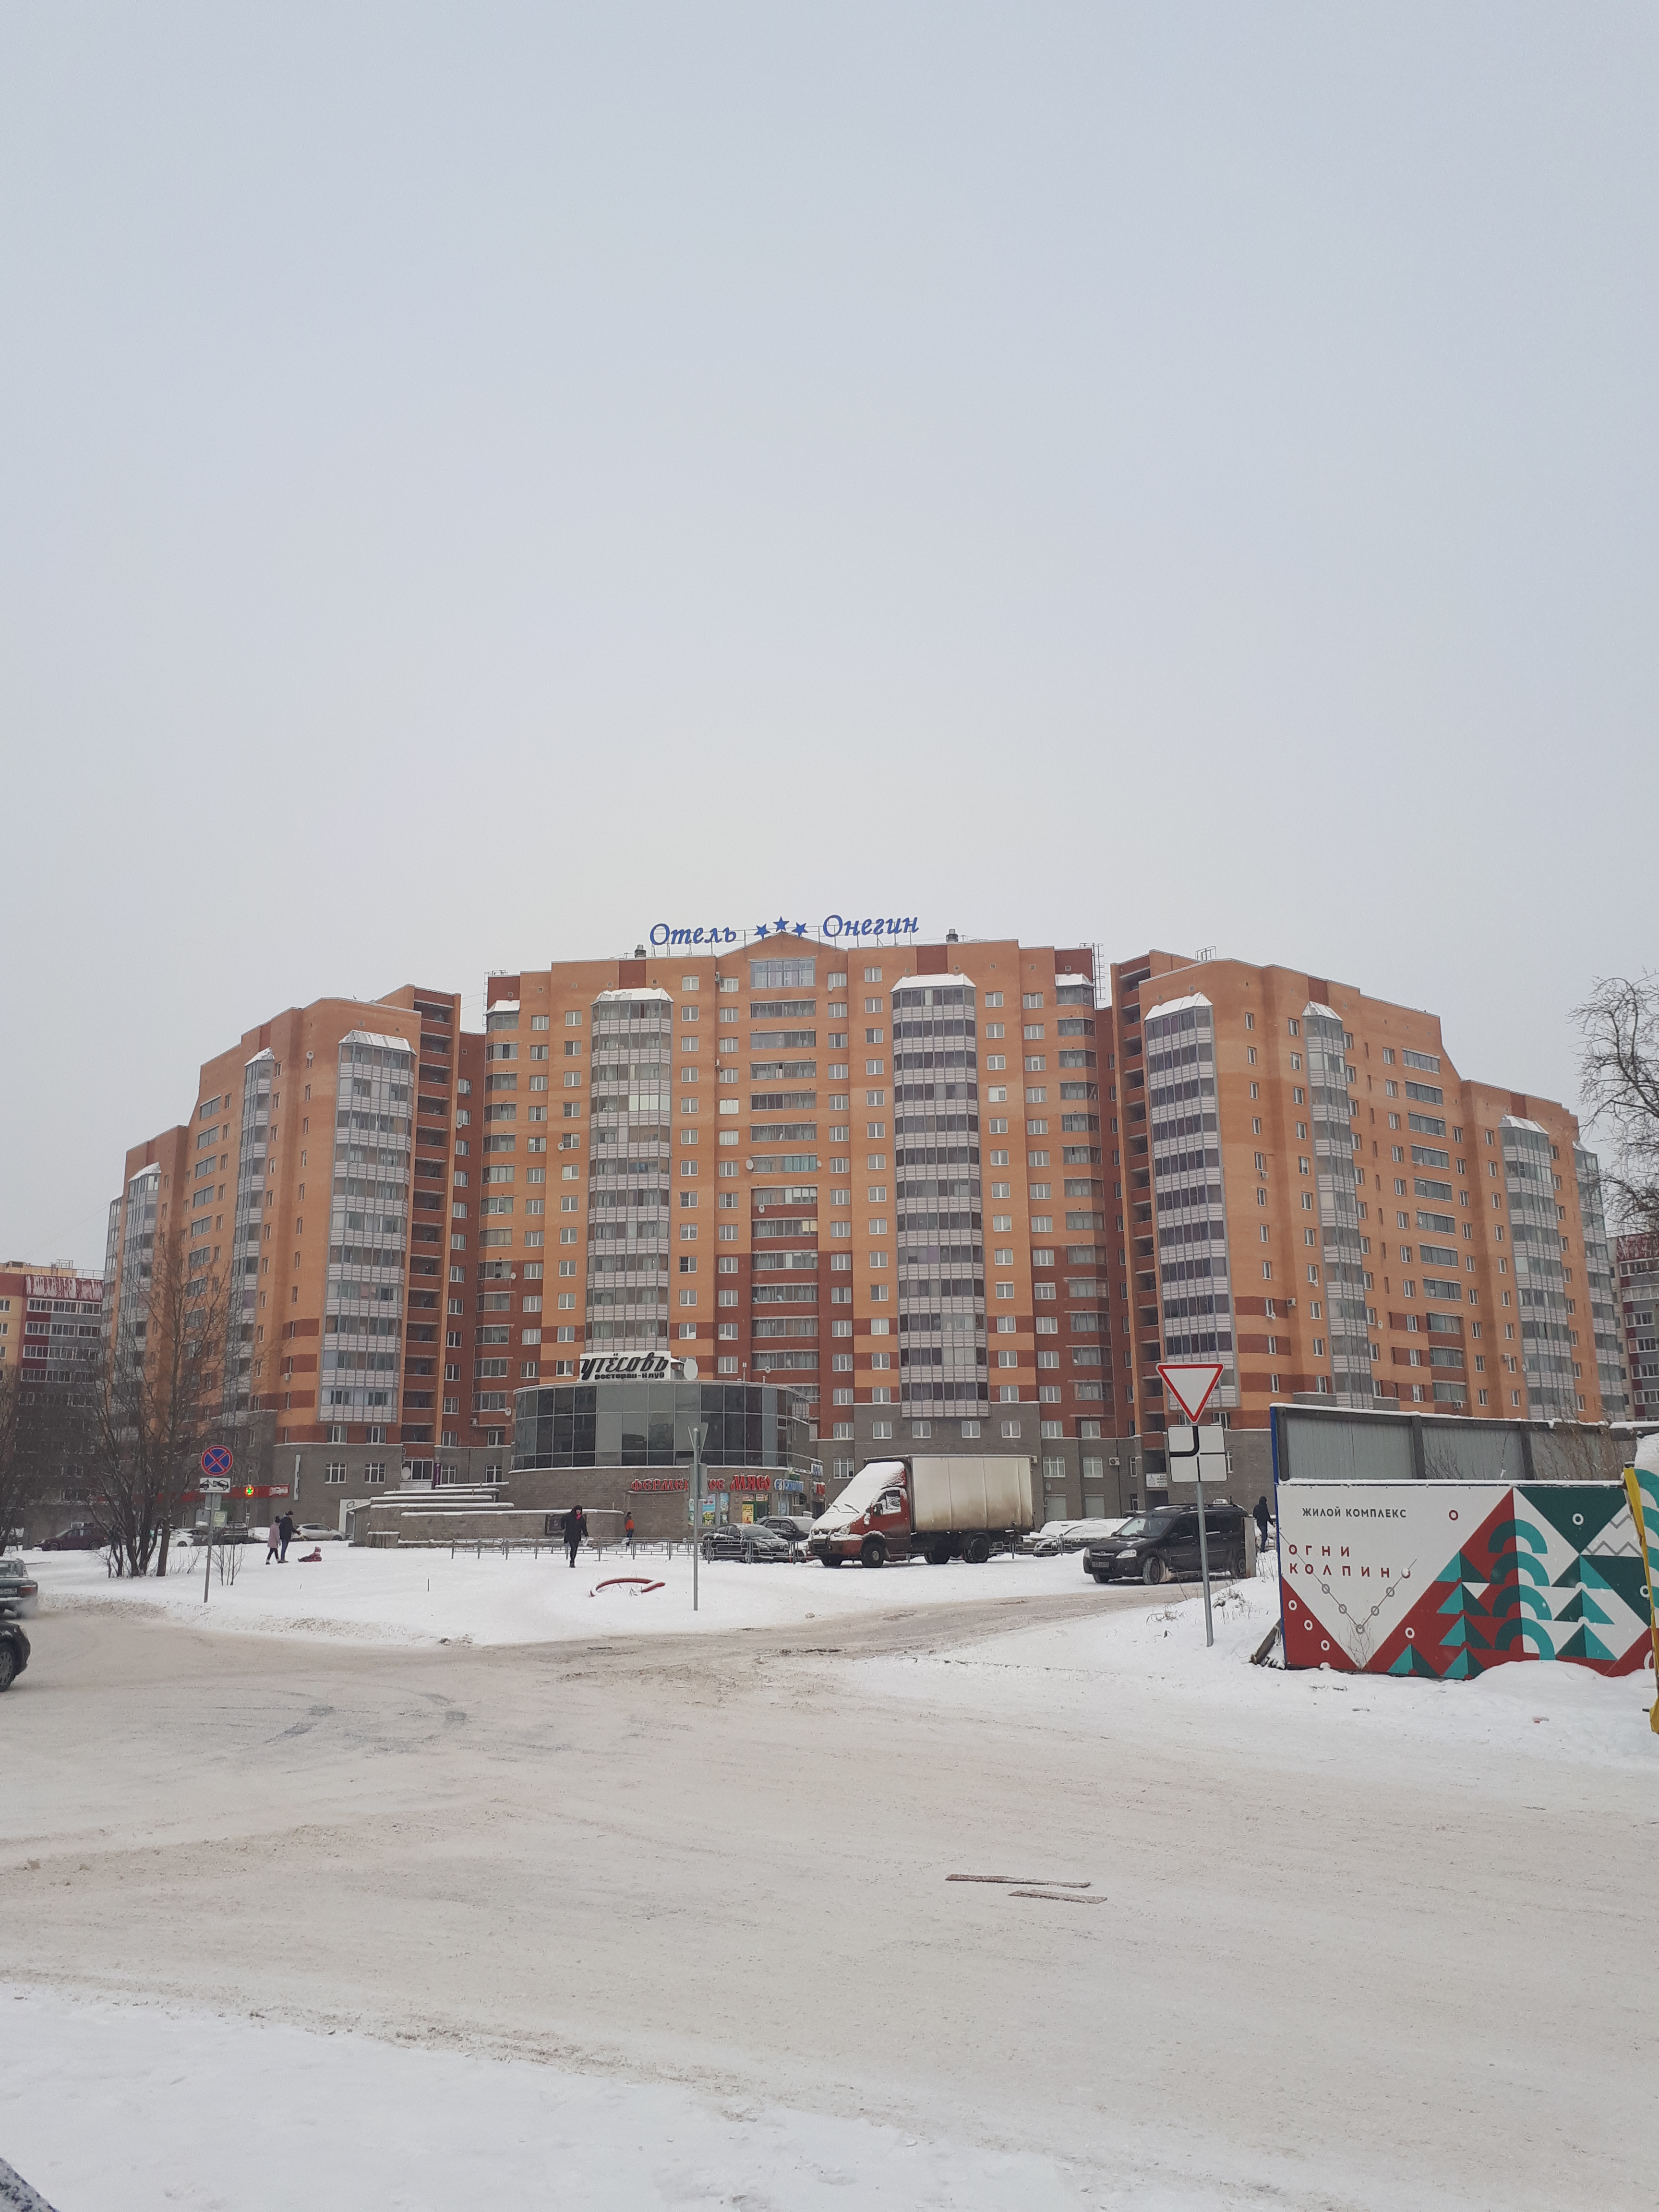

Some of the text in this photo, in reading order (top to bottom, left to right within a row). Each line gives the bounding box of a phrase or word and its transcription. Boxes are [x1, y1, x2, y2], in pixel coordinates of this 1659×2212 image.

[649, 914, 919, 946] Отель Онегин
[631, 1478, 725, 1491] ФЕРМЕОЕ
[730, 1475, 771, 1491] МЯСО
[1302, 1506, 1407, 1518] ЖИЛОЙ КОМПЛЕКС
[1288, 1544, 1349, 1557] ОГНИ
